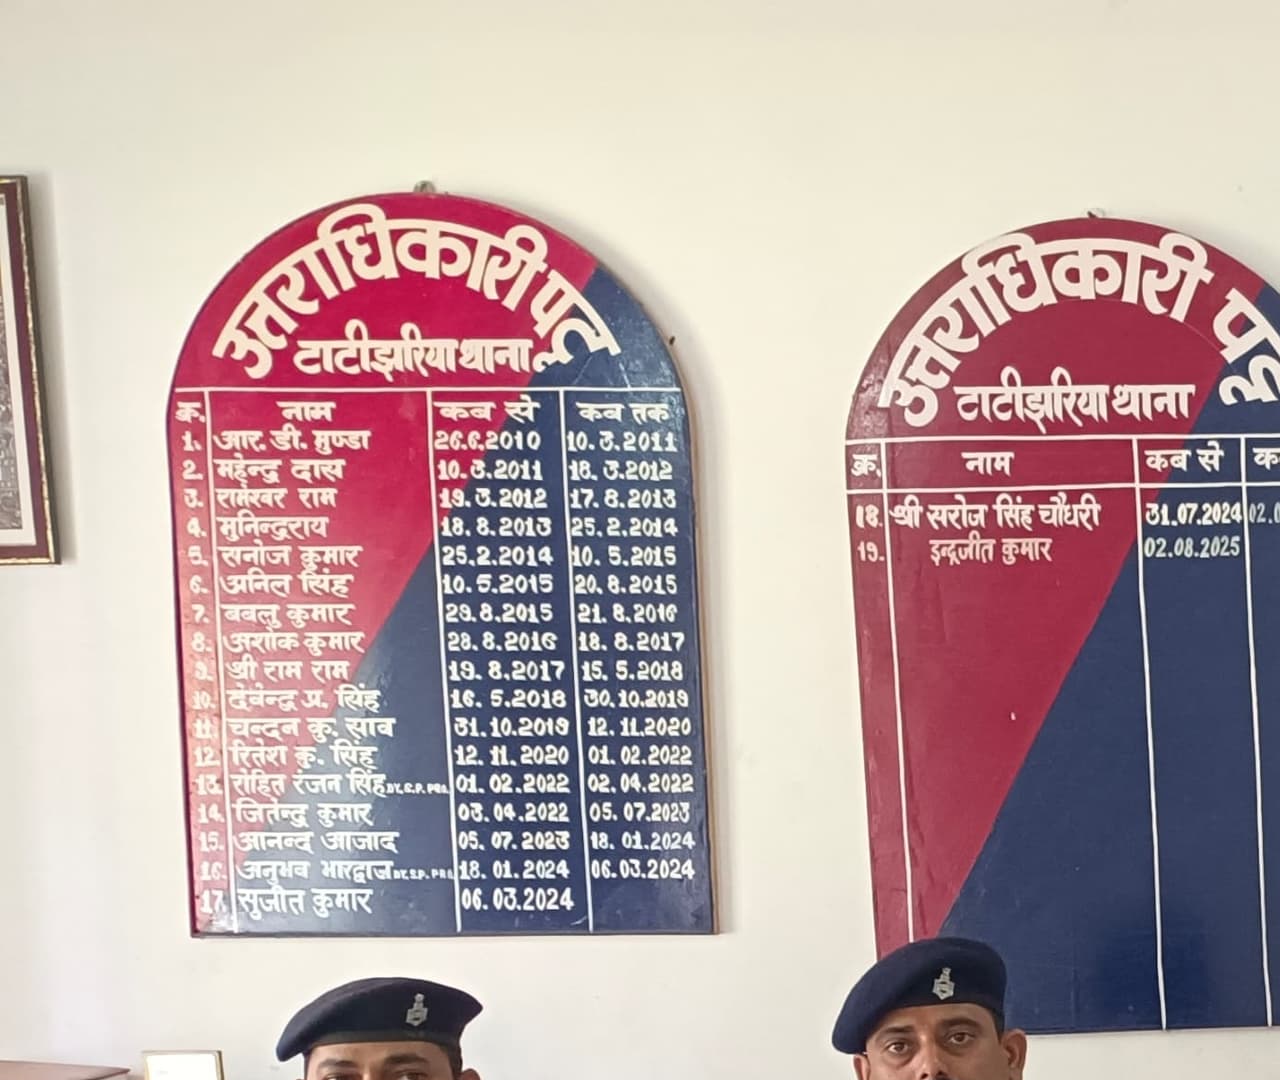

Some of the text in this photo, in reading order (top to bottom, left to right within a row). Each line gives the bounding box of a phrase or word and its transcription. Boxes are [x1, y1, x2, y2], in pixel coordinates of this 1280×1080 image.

[212, 203, 548, 379] उत्तराधिकारी
[877, 232, 1215, 427] उत्तराधिकारी
[459, 338, 534, 374] थाना
[276, 401, 336, 421] नाम
[433, 402, 496, 422] कब
[503, 394, 541, 424] से
[576, 402, 625, 422] कब
[628, 402, 669, 424] तक
[1112, 384, 1195, 420] थाना
[269, 423, 308, 452] डी.
[312, 430, 371, 455] मुण्डा
[213, 453, 282, 484] महेन्द्र
[291, 459, 346, 483] दास
[961, 452, 1015, 476] नाम
[1144, 449, 1191, 472] कब
[1196, 440, 1224, 472] से
[298, 488, 338, 509] राम
[855, 504, 883, 528] 18.
[889, 494, 923, 528] श्री
[926, 493, 988, 530] सरोज
[992, 492, 1035, 531] सिंह
[1038, 491, 1101, 530] चौधरी
[1145, 502, 1243, 526] 31.07.2024
[298, 546, 363, 572] कुमार
[858, 530, 1240, 566] 19. इन्द्रजीत कुमार 02.08.2025
[220, 567, 292, 597] अनिल
[297, 568, 354, 598] सिंह
[286, 604, 356, 628] कुमार
[222, 626, 300, 654] अशोक
[303, 632, 365, 656] कुमार
[226, 654, 258, 681] श्री
[263, 661, 302, 682] राम
[311, 660, 350, 682] राम
[334, 683, 381, 712] सिंह
[227, 717, 300, 742] चन्दन
[306, 718, 338, 742] कु.
[345, 717, 396, 740] साव
[229, 739, 288, 767] रितेश
[293, 747, 324, 771] कु.
[330, 741, 378, 770] सिंह
[231, 768, 287, 796] रोहित
[293, 768, 342, 794] रंजन
[346, 767, 386, 797] सिंह
[232, 797, 309, 827] जितेन्द्र
[317, 804, 374, 827] कुमार
[232, 831, 314, 853] आनन्द
[320, 831, 399, 853] आजाद
[235, 860, 310, 885] अनुभव
[320, 860, 393, 883] भारद्वाज
[237, 885, 305, 919] सुजीत
[311, 888, 374, 918] कुमार
